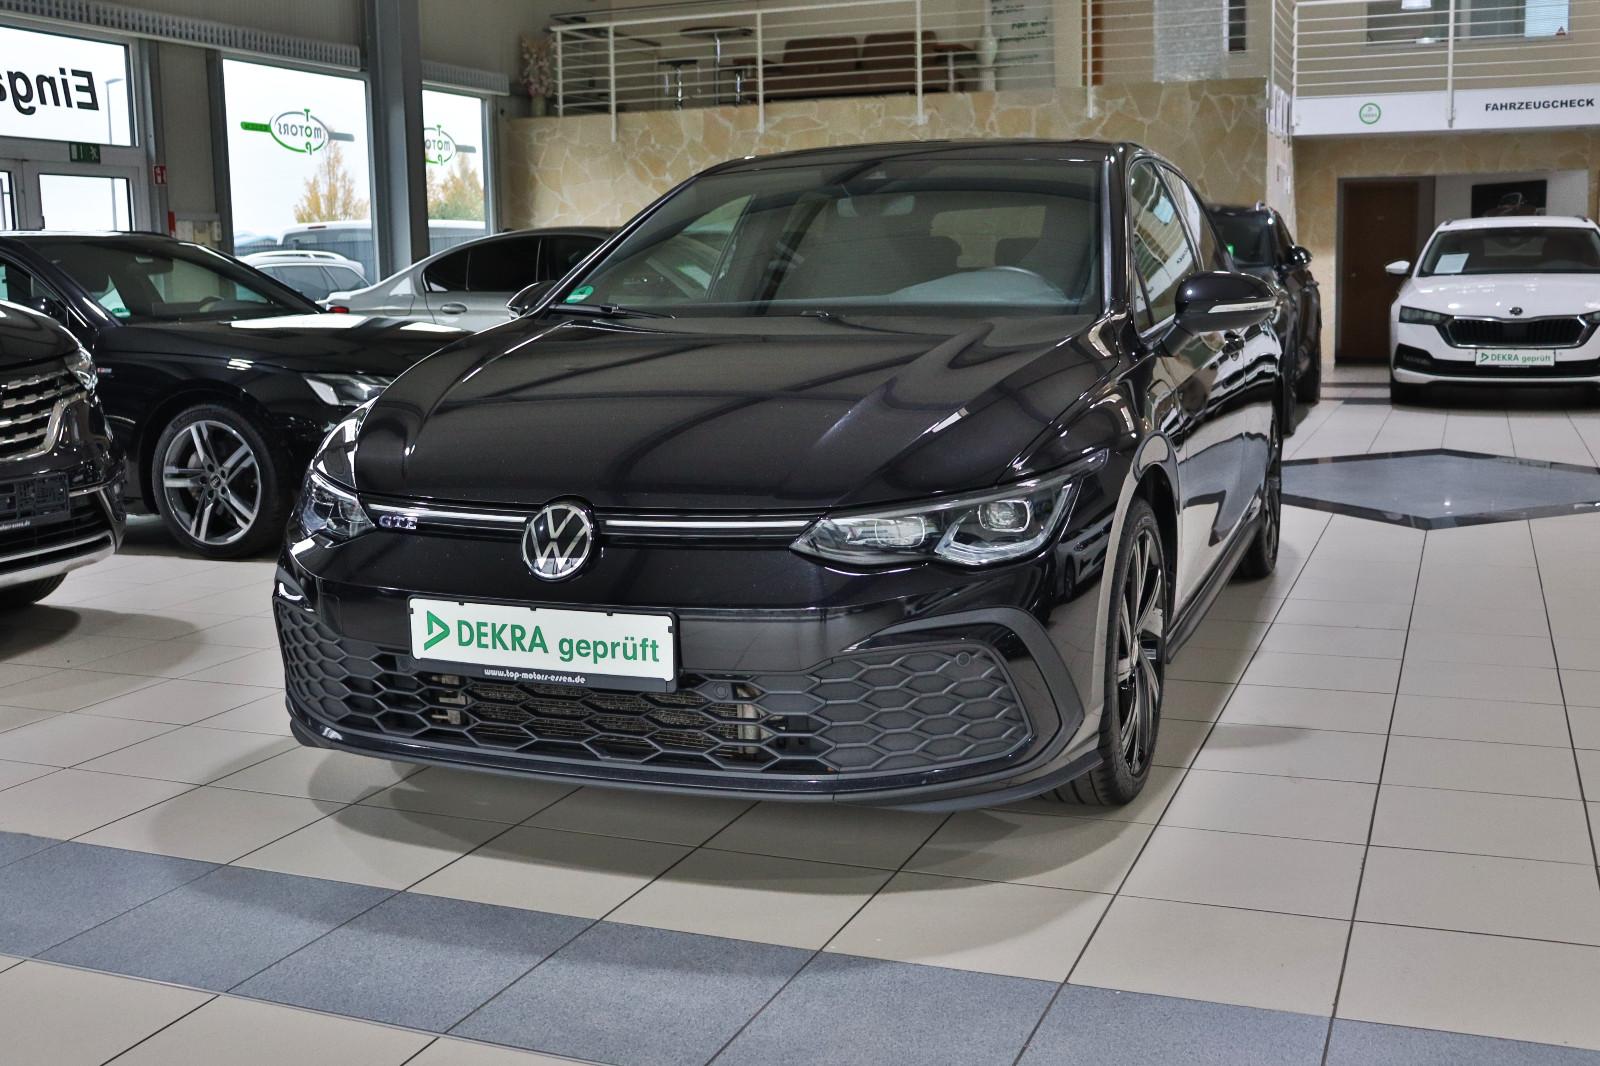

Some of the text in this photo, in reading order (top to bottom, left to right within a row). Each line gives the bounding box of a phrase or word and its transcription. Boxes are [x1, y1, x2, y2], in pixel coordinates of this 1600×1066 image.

[1485, 98, 1595, 112] FAHRZEUGCHECK
[1491, 353, 1551, 363] DEKRA geprüft
[379, 515, 417, 530] GTE
[457, 619, 660, 664] DEKRA geprüft
[484, 669, 586, 684] www.top-motors-essen.de
